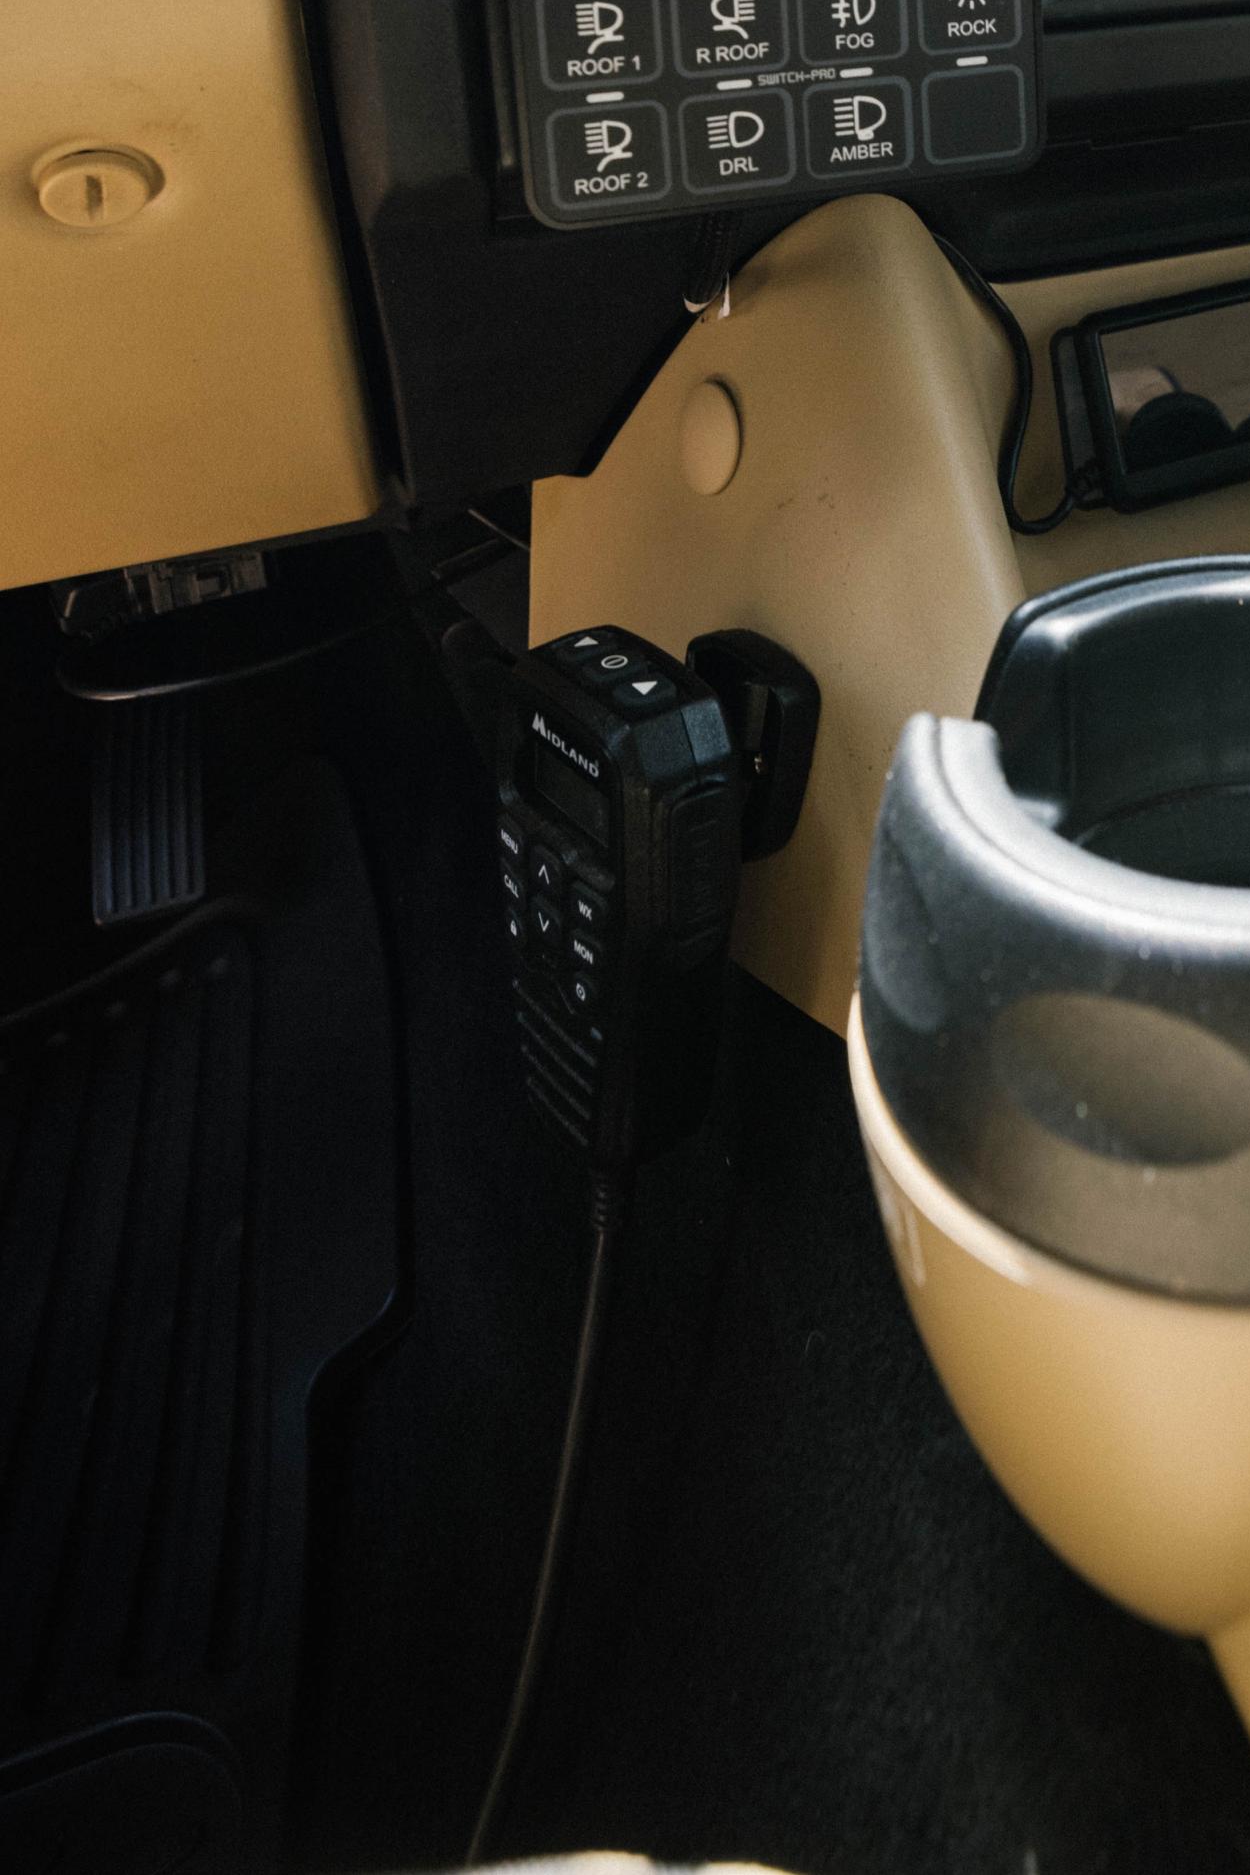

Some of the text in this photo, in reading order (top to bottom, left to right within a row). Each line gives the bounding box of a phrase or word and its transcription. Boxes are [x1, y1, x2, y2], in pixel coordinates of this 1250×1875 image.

[946, 18, 998, 38] ROCK
[834, 31, 876, 50] FOG
[695, 42, 770, 64] R ROOF
[566, 55, 641, 77] ROOF 1
[829, 141, 894, 163] AMBER
[718, 156, 759, 176] DRL
[574, 171, 649, 195] ROOF 2
[531, 711, 600, 778] MIDLAND
[500, 828, 519, 855] MENU
[503, 873, 520, 899] CALL
[577, 899, 593, 922] WX
[573, 938, 594, 966] MON
